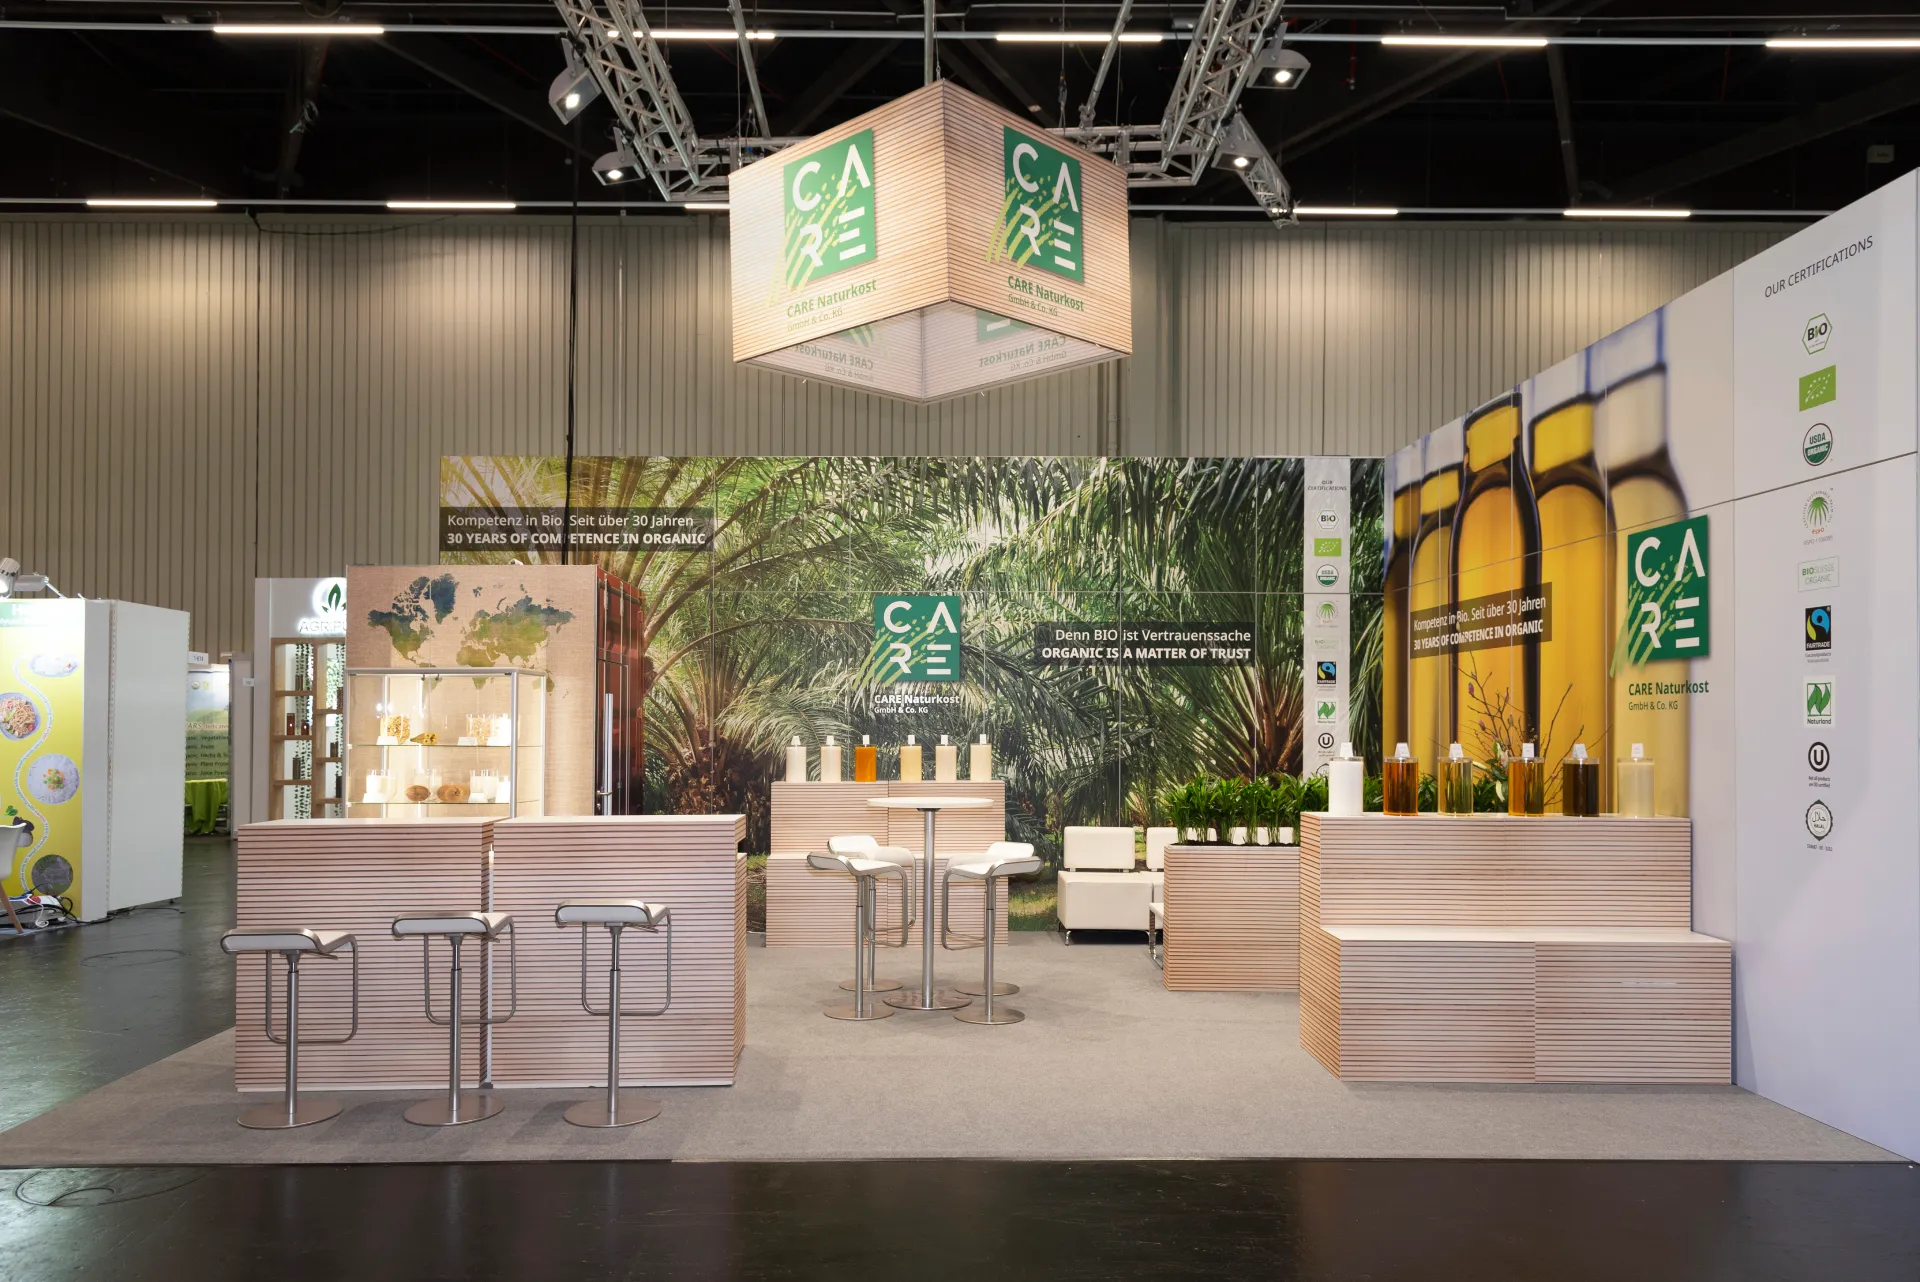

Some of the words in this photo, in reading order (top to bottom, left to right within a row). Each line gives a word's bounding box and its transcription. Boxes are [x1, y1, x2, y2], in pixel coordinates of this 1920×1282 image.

[1764, 279, 1786, 298] OUR
[1788, 235, 1873, 287] CERTIFICATIONS
[787, 299, 814, 317] CARE
[818, 280, 877, 308] Naturkost
[1008, 275, 1034, 295] CARE
[1036, 284, 1084, 311] Naturkost
[1008, 294, 1030, 307] GmbH
[1031, 301, 1035, 309] &
[1037, 303, 1048, 313] Co.
[1049, 307, 1058, 316] KG
[787, 319, 809, 331] GmbH
[811, 315, 817, 324] &
[832, 308, 843, 318] KG
[1809, 432, 1826, 445] USDA
[447, 514, 522, 529] Kompetenz
[526, 514, 538, 526] in
[541, 514, 565, 526] Bio.
[569, 515, 595, 526] Seit
[598, 514, 629, 526] über
[632, 515, 649, 526] 30
[650, 515, 694, 529] Jahren
[447, 533, 463, 544] 30
[466, 533, 507, 544] YEARS
[510, 533, 528, 544] OF
[622, 533, 640, 544] IN
[642, 533, 706, 544] ORGANIC
[1805, 574, 1831, 585] ORGANIC
[1413, 615, 1448, 633] Kompetenz
[1448, 612, 1456, 625] in
[1456, 609, 1470, 623] Bio.
[1471, 606, 1486, 621] Seit
[1486, 602, 1505, 618] über
[1506, 599, 1518, 615] 30
[1518, 596, 1546, 616] Jahren
[1055, 629, 1090, 641] Denn
[1094, 629, 1118, 641] BIO
[1123, 629, 1139, 641] ist
[1141, 629, 1251, 641] Vertrauenssache
[1413, 639, 1421, 651] 30
[1421, 636, 1440, 649] YEARS
[1441, 634, 1449, 646] OF
[1450, 626, 1494, 645] COMPETENCE
[1494, 625, 1504, 639] IN
[1505, 619, 1543, 637] ORGANIC
[1806, 641, 1831, 649] FAIRTRADE
[1042, 647, 1103, 659] ORGANIC
[1106, 648, 1119, 659] IS
[1122, 648, 1133, 659] A
[1135, 648, 1187, 659] MATTER
[1190, 648, 1207, 659] OF
[1210, 648, 1251, 659] TRUST
[1628, 682, 1653, 696] CARE
[1656, 680, 1709, 695] Naturkost
[874, 694, 902, 704] CARE
[904, 694, 960, 704] Naturkost
[1628, 702, 1648, 711] GmbH
[1650, 701, 1655, 710] &
[1656, 701, 1667, 710] Co.
[1668, 700, 1678, 710] KG
[874, 706, 897, 714] GmbH
[918, 706, 929, 714] KG
[187, 722, 202, 730] ARS
